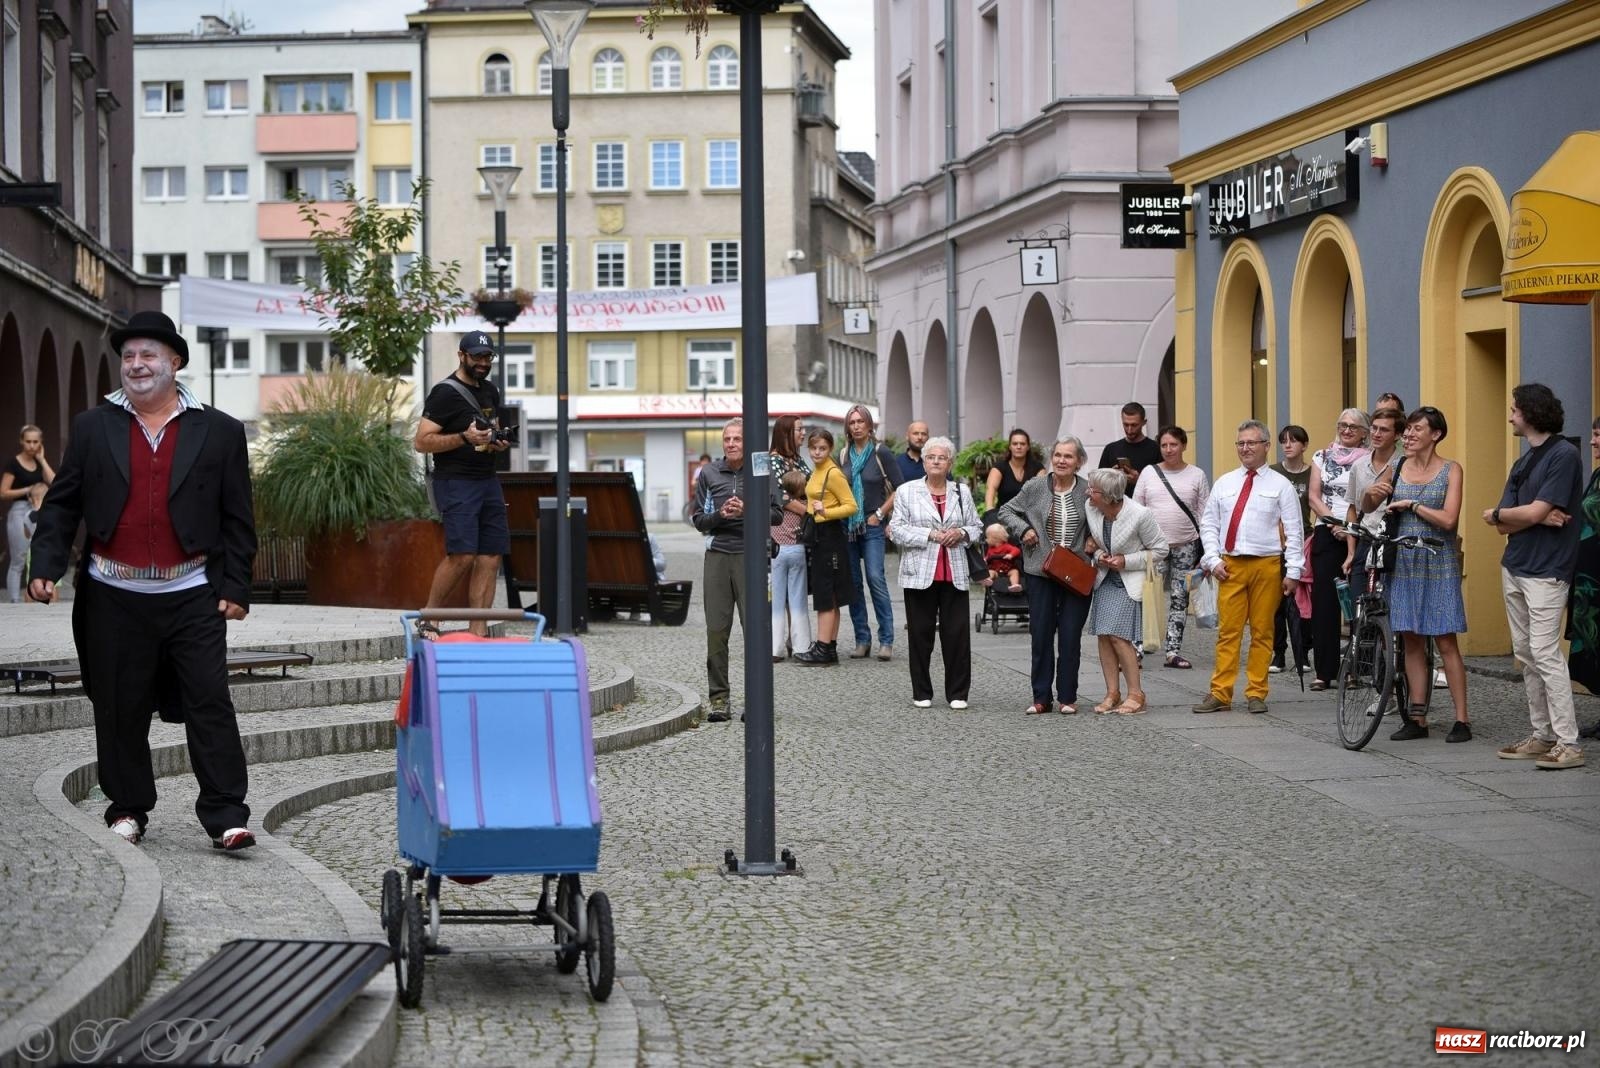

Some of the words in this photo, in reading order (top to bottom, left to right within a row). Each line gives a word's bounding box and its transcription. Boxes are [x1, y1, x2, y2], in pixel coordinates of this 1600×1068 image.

[1128, 197, 1181, 209] JUBILER
[1216, 165, 1285, 224] JUBILER
[1290, 160, 1304, 190] M.
